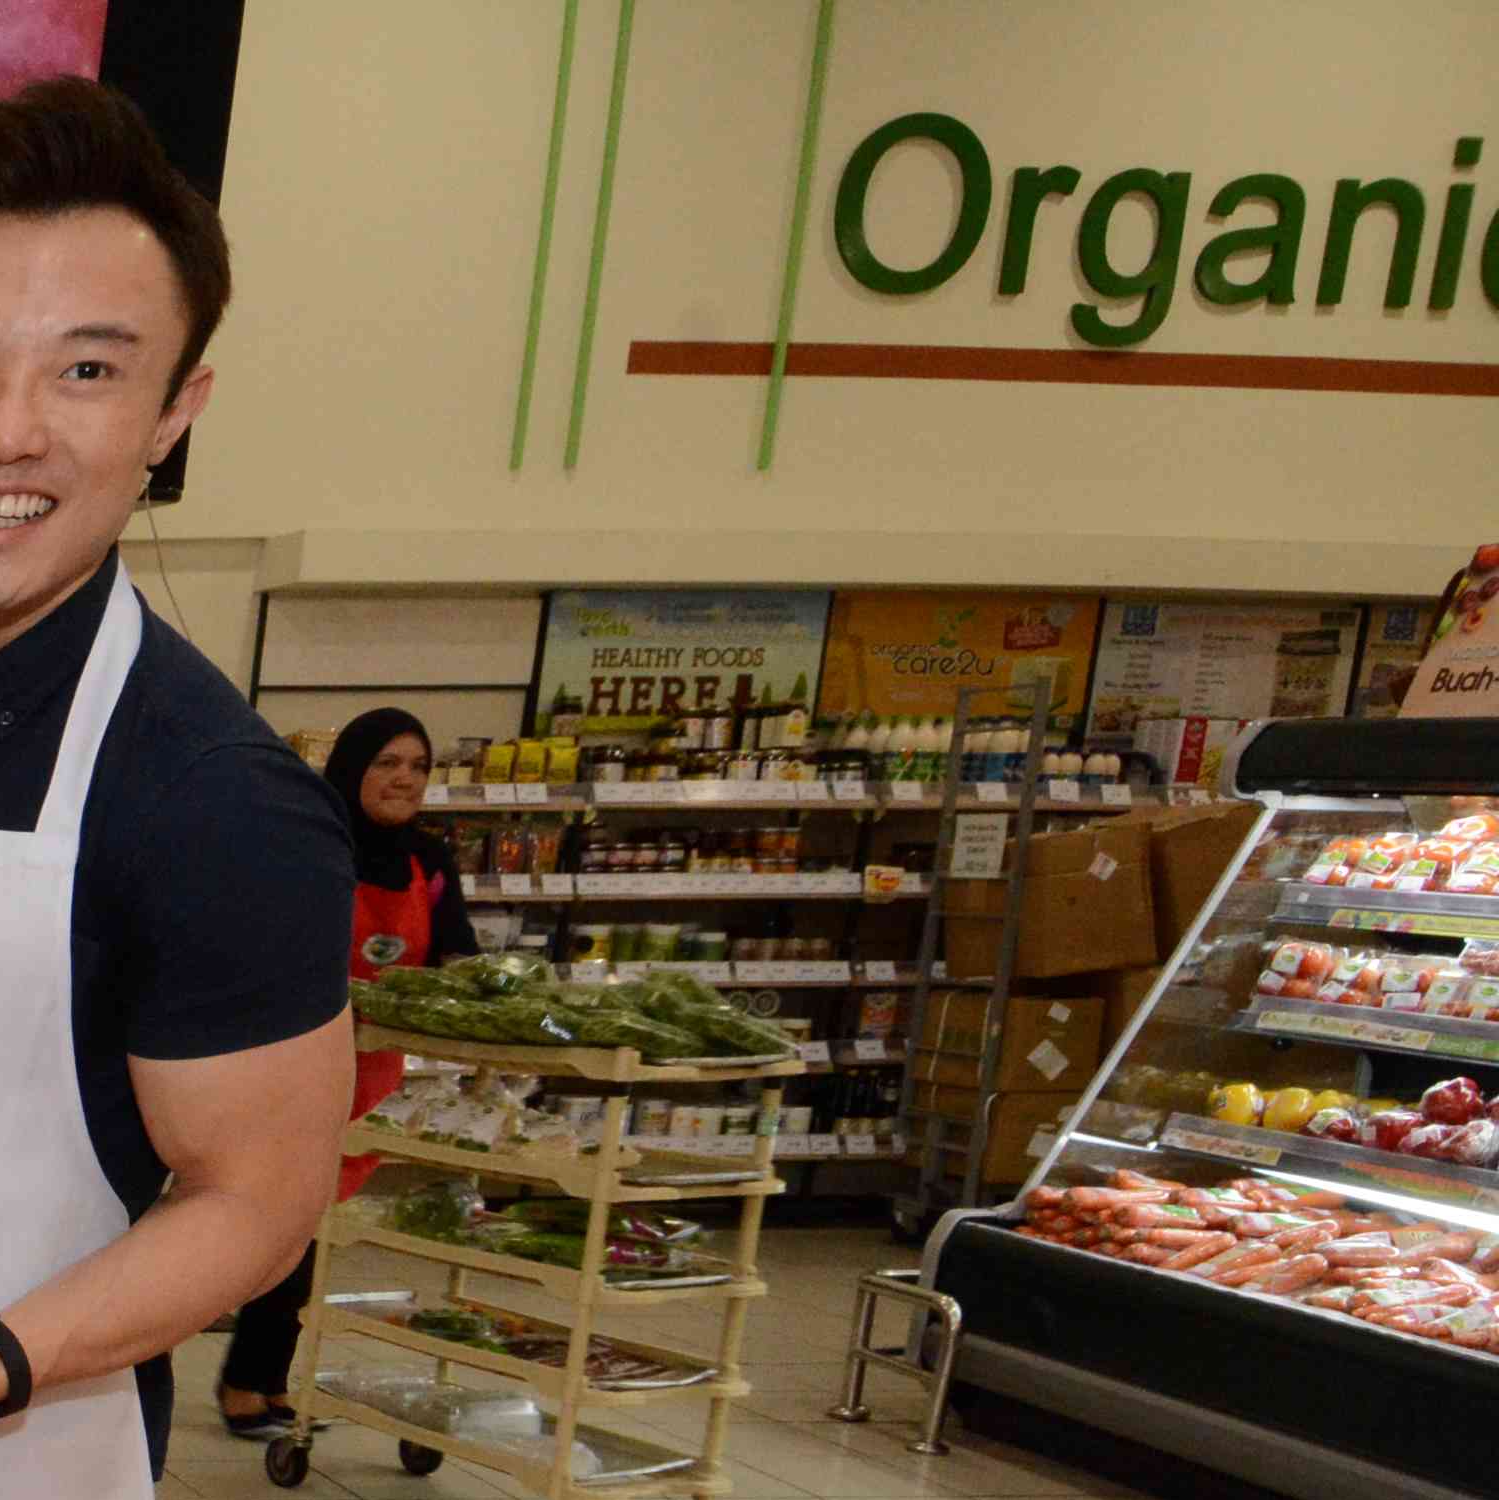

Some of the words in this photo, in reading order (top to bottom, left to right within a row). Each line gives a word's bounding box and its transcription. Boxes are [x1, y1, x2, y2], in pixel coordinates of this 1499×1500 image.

[834, 111, 1499, 348] Organi
[591, 648, 684, 668] HEALTHY
[692, 647, 765, 668] FOODS
[893, 650, 995, 675] care2u
[586, 675, 721, 717] HERE
